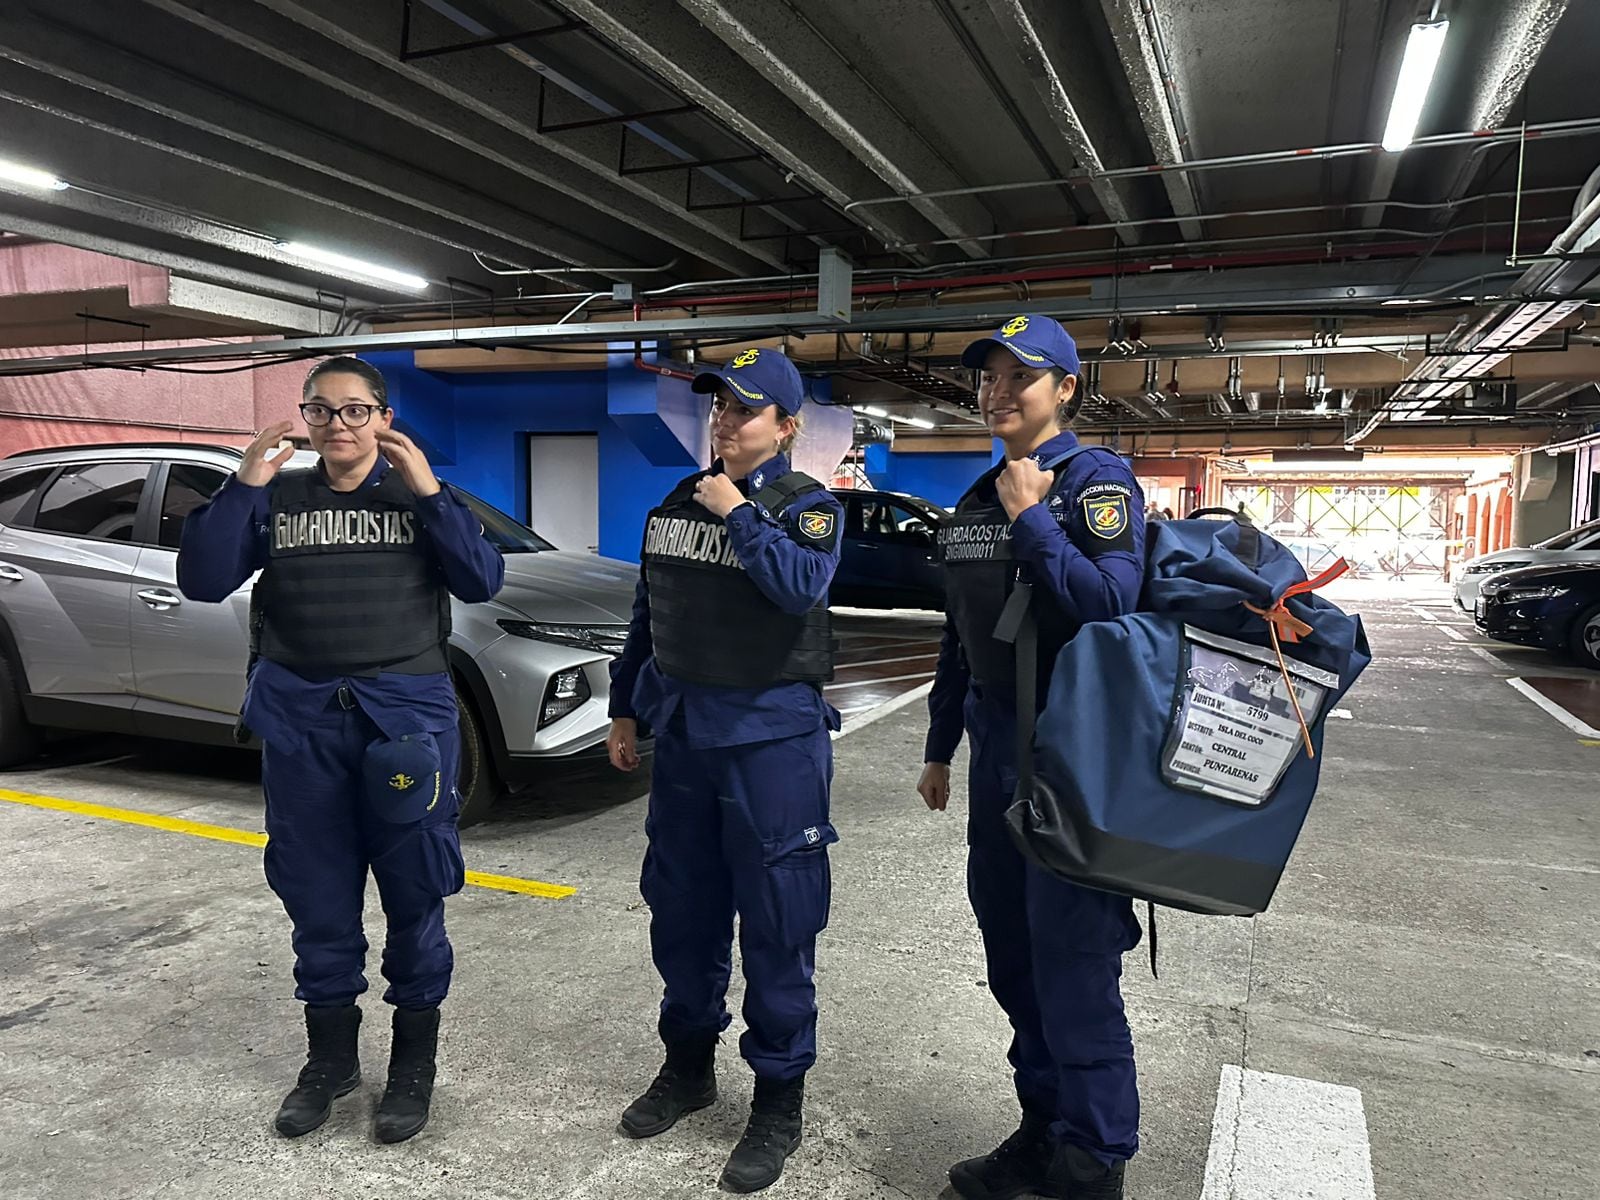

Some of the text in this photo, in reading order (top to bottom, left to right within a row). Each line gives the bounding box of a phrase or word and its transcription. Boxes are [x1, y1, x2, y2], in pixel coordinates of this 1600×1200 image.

[1104, 483, 1132, 497] NACIONAL
[274, 509, 415, 549] GUARDACOSTAS
[1192, 692, 1216, 709] JUNTA
[1246, 706, 1269, 722] 5799
[1187, 721, 1214, 737] DISTRITO:
[1217, 724, 1234, 736] ISLA
[1234, 730, 1247, 741] DEL
[1247, 735, 1264, 746] COCO
[1211, 742, 1247, 760] CENTRAL
[1203, 758, 1260, 783] PUNTARENAS
